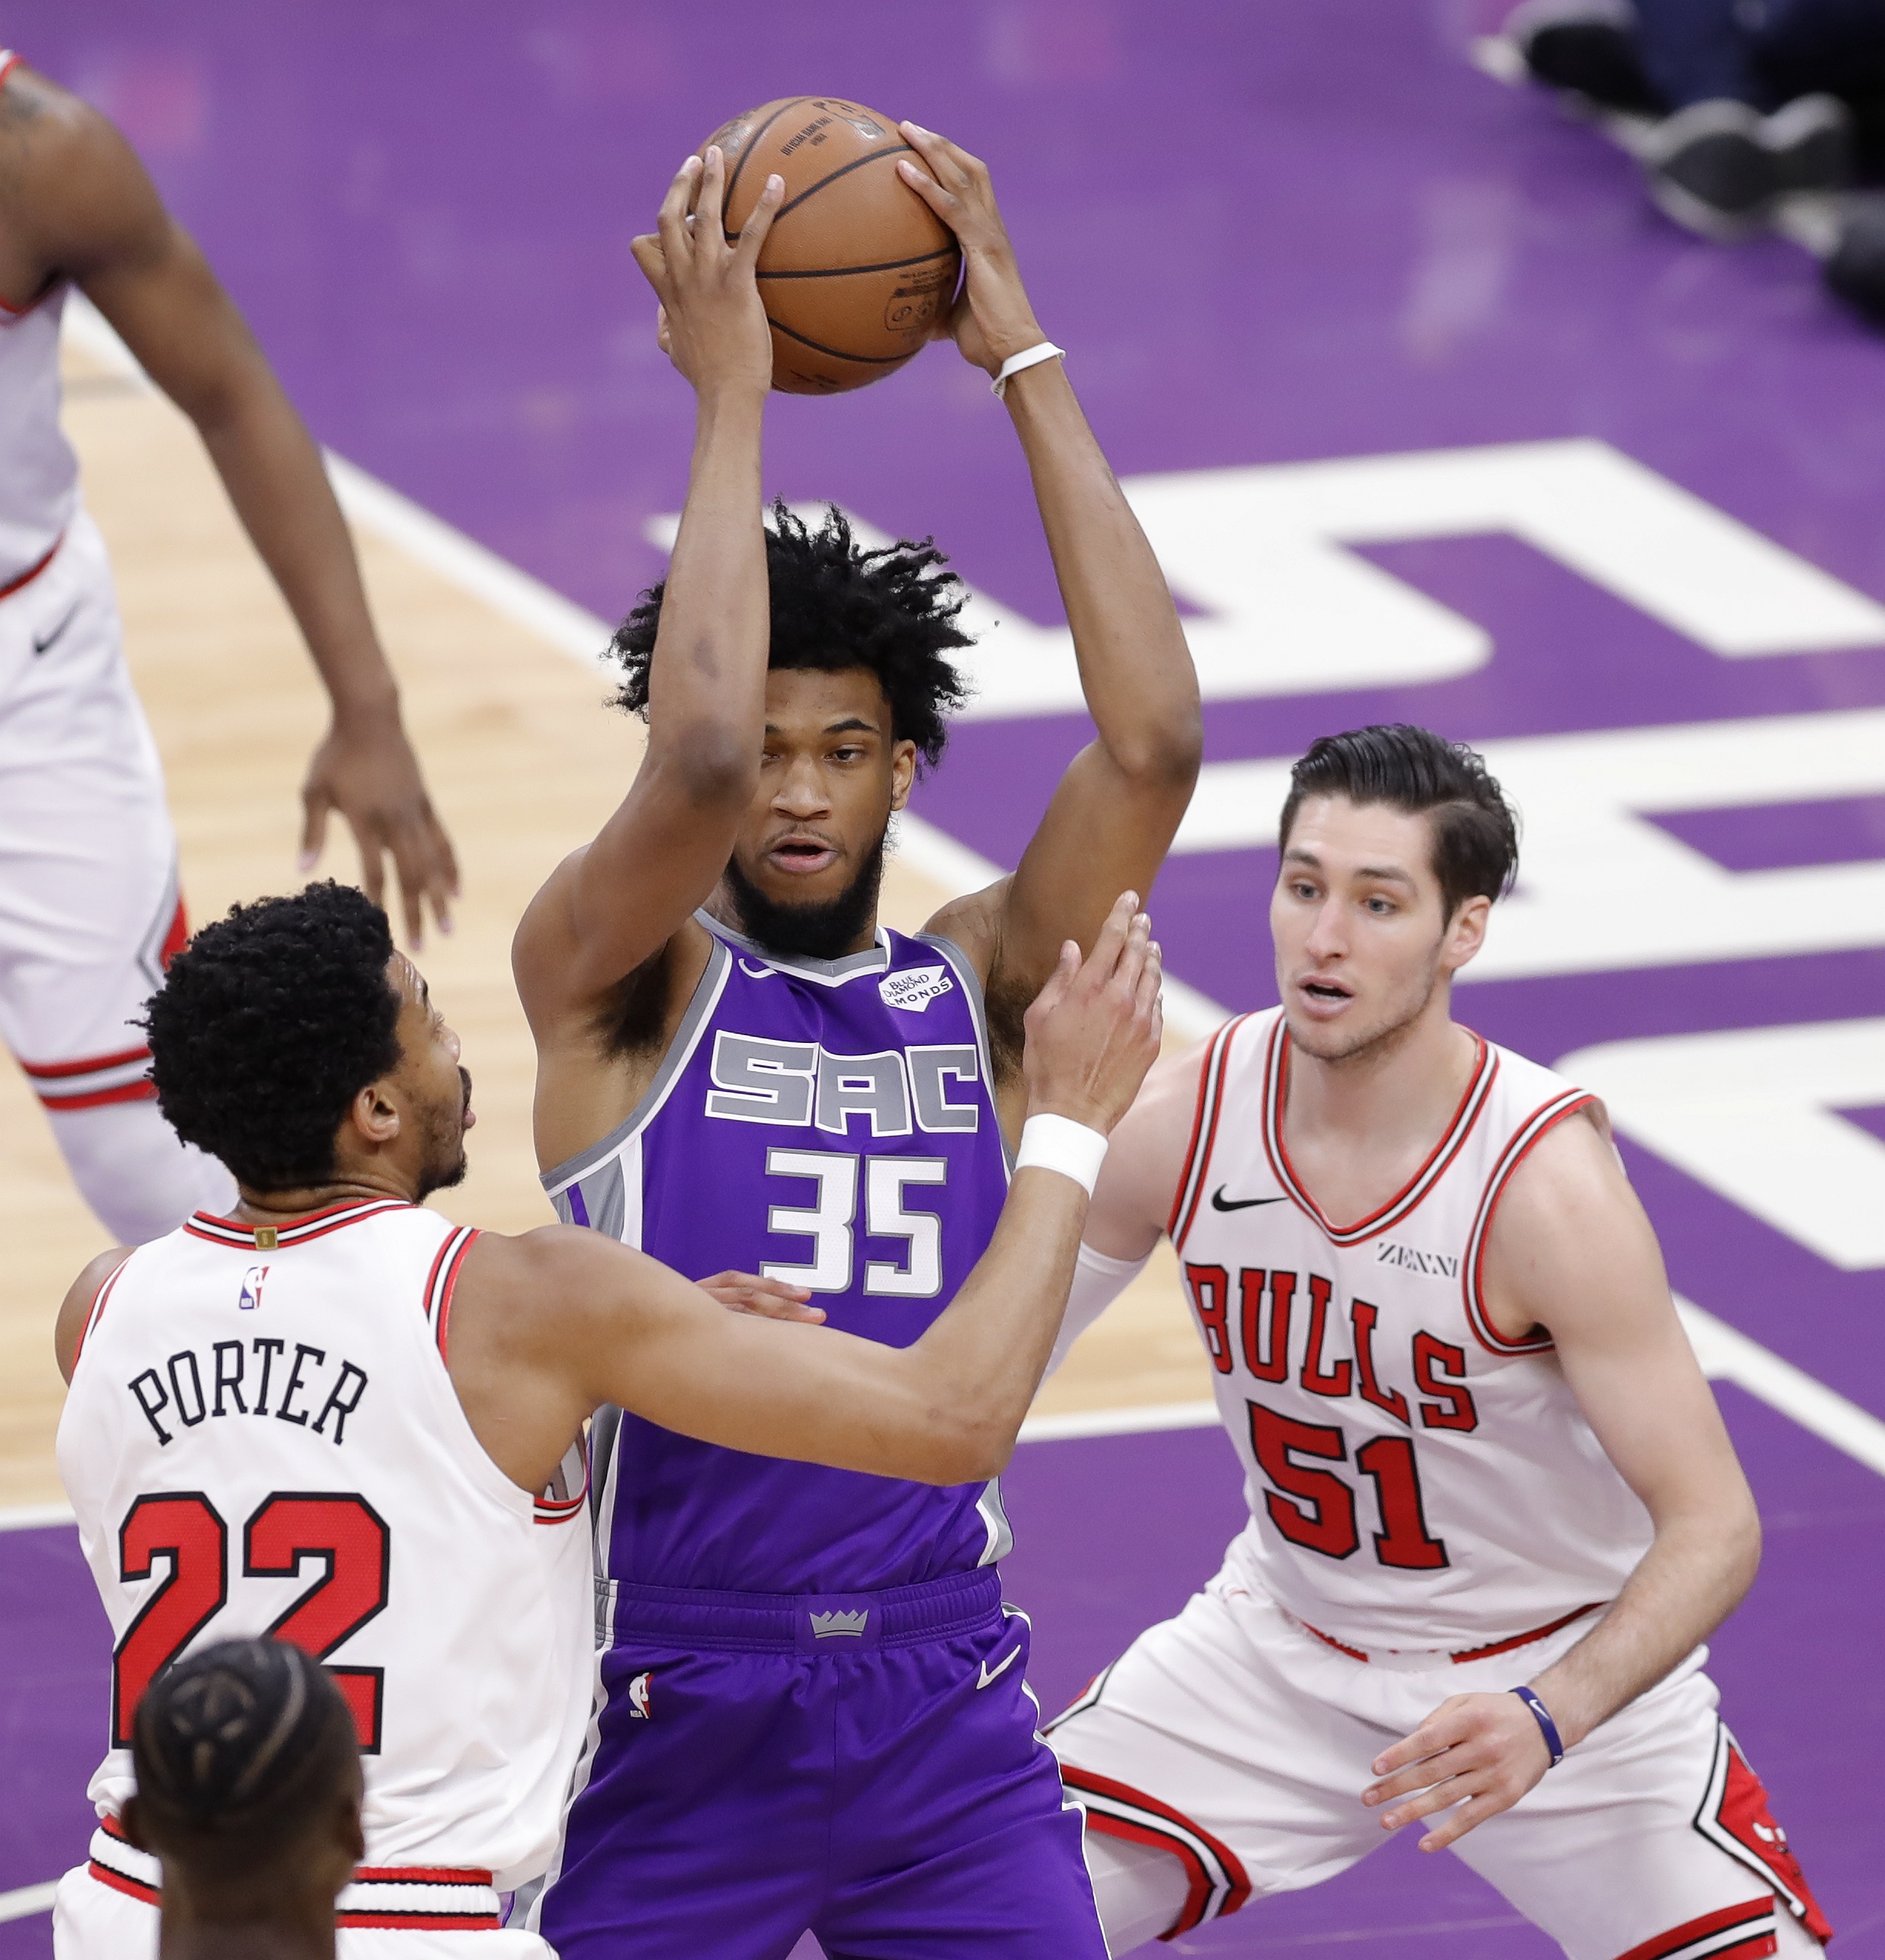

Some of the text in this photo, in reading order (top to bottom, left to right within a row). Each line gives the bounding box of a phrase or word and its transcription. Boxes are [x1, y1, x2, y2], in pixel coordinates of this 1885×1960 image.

[883, 974, 930, 998] DIAMOND
[883, 980, 950, 1006] LMONDS
[889, 974, 915, 990] BLUE
[705, 1029, 978, 1137] SAC
[759, 1146, 948, 1298] 35
[128, 1337, 368, 1446] PORTER
[1185, 1261, 1478, 1432] BULLS
[1245, 1398, 1450, 1570] 51
[112, 1491, 390, 1756] 22
